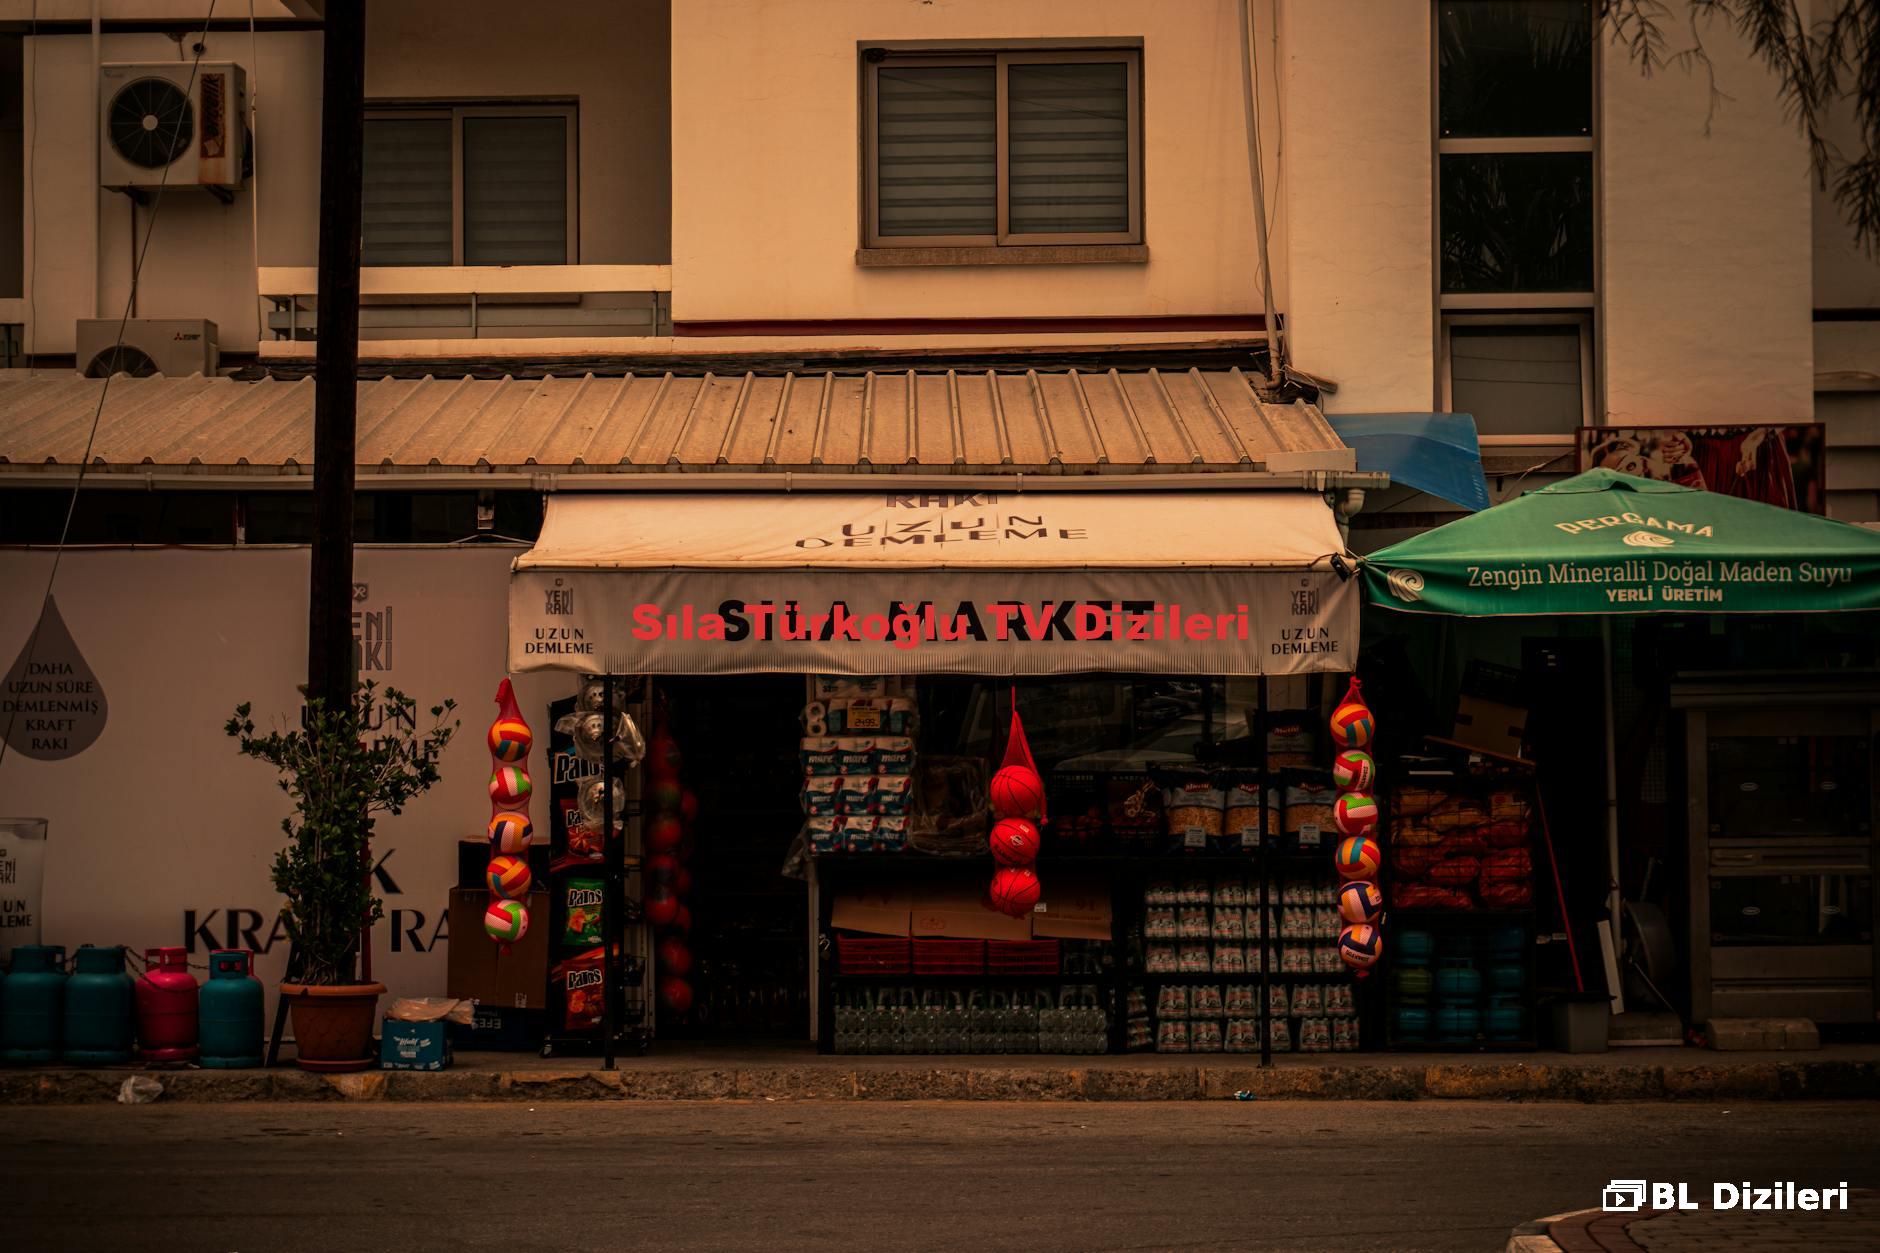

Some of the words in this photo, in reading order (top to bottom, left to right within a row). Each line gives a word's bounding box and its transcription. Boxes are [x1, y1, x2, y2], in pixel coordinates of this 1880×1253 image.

[842, 514, 1042, 537] UZUN
[1554, 512, 1714, 538] PERGAMA
[796, 526, 1088, 549] DEMLEME
[1467, 563, 1543, 590] Zengin
[1548, 560, 1647, 584] Mineralli
[1653, 560, 1714, 587] Doğal
[1720, 561, 1793, 582] Maden
[1799, 562, 1852, 587] Suyu
[1606, 585, 1653, 602] YERLİ
[1662, 585, 1723, 602] ÜRETİM
[352, 606, 393, 641] ENİ
[535, 627, 584, 640] UZUN
[1281, 627, 1329, 641] UZUN
[525, 642, 594, 654] DEMLEME
[1271, 640, 1338, 655] DEMLEME
[29, 662, 74, 675] DAHA
[8, 681, 52, 694] UZUN
[55, 679, 94, 694] SÜRE
[2, 699, 99, 715] DEMLENMİŞ
[25, 718, 77, 732] KRAFT
[31, 737, 68, 750] RAKI
[0, 914, 32, 928] LEME
